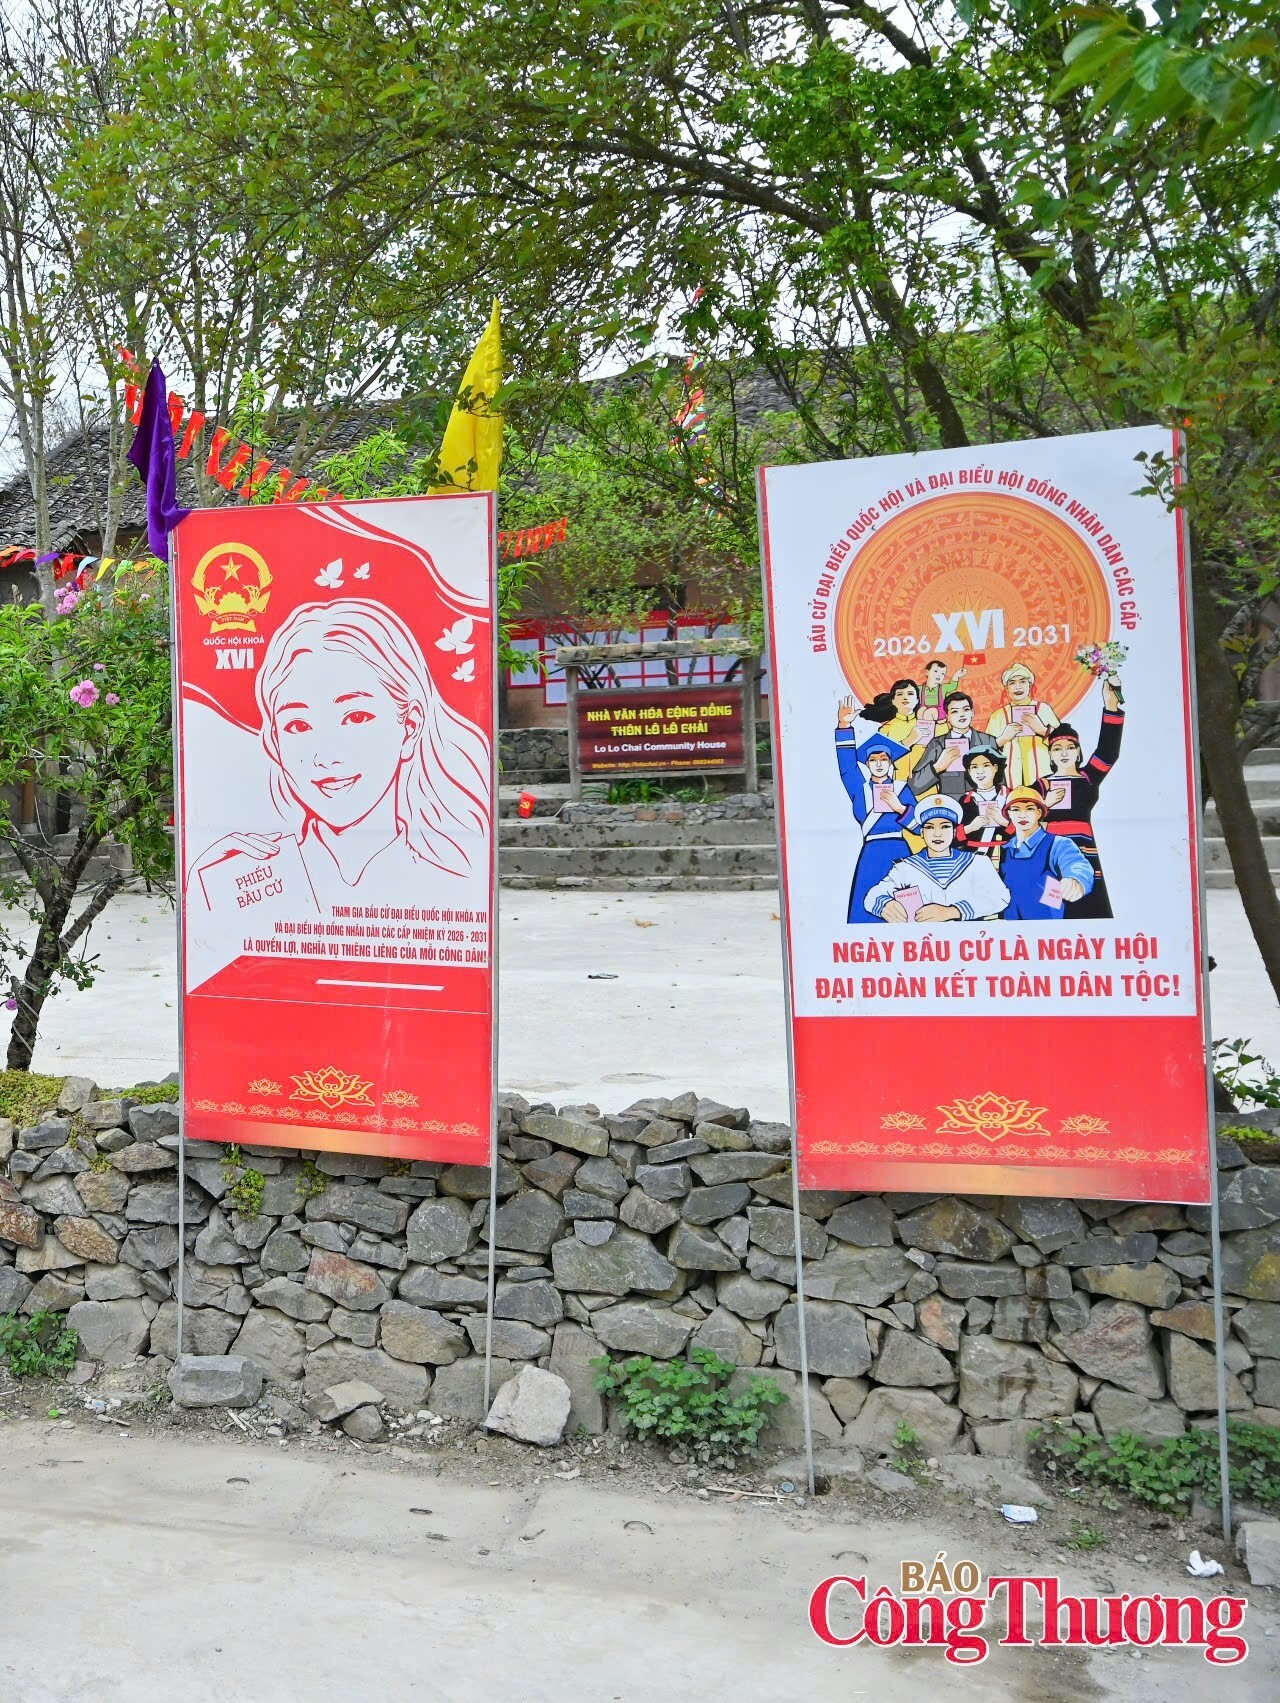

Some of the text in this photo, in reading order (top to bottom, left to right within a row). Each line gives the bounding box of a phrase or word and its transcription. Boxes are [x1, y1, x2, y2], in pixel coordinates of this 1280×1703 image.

[928, 471, 954, 490] ĐẠI
[959, 464, 993, 484] BIỂU
[998, 470, 1024, 491] HỘI
[905, 477, 926, 498] VÀ
[878, 489, 905, 512] HỘI
[846, 507, 881, 541] QUỐC
[1065, 499, 1104, 537] NHÂN
[825, 539, 852, 572] BIỂU
[1096, 533, 1124, 566] DÂN
[816, 573, 836, 598] ĐẠI
[1112, 567, 1136, 597] CÁC
[808, 598, 827, 620] CỬ
[1120, 601, 1142, 631] CẤP
[203, 636, 226, 646] QUỐC
[228, 636, 241, 646] HỘI
[807, 625, 827, 652] BẦU
[873, 608, 1070, 657] 2026 XVI 2031
[215, 648, 254, 669] XVI
[587, 709, 611, 721] NHÀ
[613, 708, 636, 720] VĂN
[639, 707, 663, 719] HÓA
[666, 706, 697, 720] CỘNG
[611, 724, 642, 736] THÔN
[645, 723, 660, 735] LÔ
[663, 721, 678, 734] LÔ
[621, 743, 642, 751] Chai
[644, 742, 695, 751] Community
[697, 741, 726, 749] House
[235, 865, 272, 890] PHIẾU
[236, 889, 261, 908] BẦU
[332, 904, 487, 924] THAM GIA BẦU CỬ ĐẠI BIỂU QUỐC HỘI KHÓA XVI
[275, 920, 283, 933] VÀ
[285, 923, 295, 936] ĐẠI
[297, 919, 311, 935] BIỂU
[313, 921, 324, 937] HỘI
[346, 924, 364, 937] NHÂN
[367, 925, 380, 938] DÂN
[382, 925, 395, 938] CÁC
[397, 924, 411, 939] CẤP
[413, 927, 434, 942] NHIỆM
[437, 927, 445, 941] KỲ
[448, 930, 464, 941] 2026
[471, 931, 487, 942] 2031
[243, 937, 253, 951] LÀ
[284, 941, 298, 956] LỢI,
[301, 940, 326, 954] NGHĨA
[329, 943, 339, 958] VỤ
[341, 942, 371, 957] THIÊNG
[373, 943, 397, 958] LIÊNG
[400, 942, 417, 959] CỦA
[420, 943, 436, 960] MỖI
[439, 946, 463, 962] CÔNG
[465, 947, 487, 963] DÂN!
[832, 930, 1158, 965] NGÀY BẦU CỬ LÀ NGÀY HỘI
[815, 968, 1180, 1004] ĐẠI ĐOÀN KẾT TOÀN DÂN TỘC!
